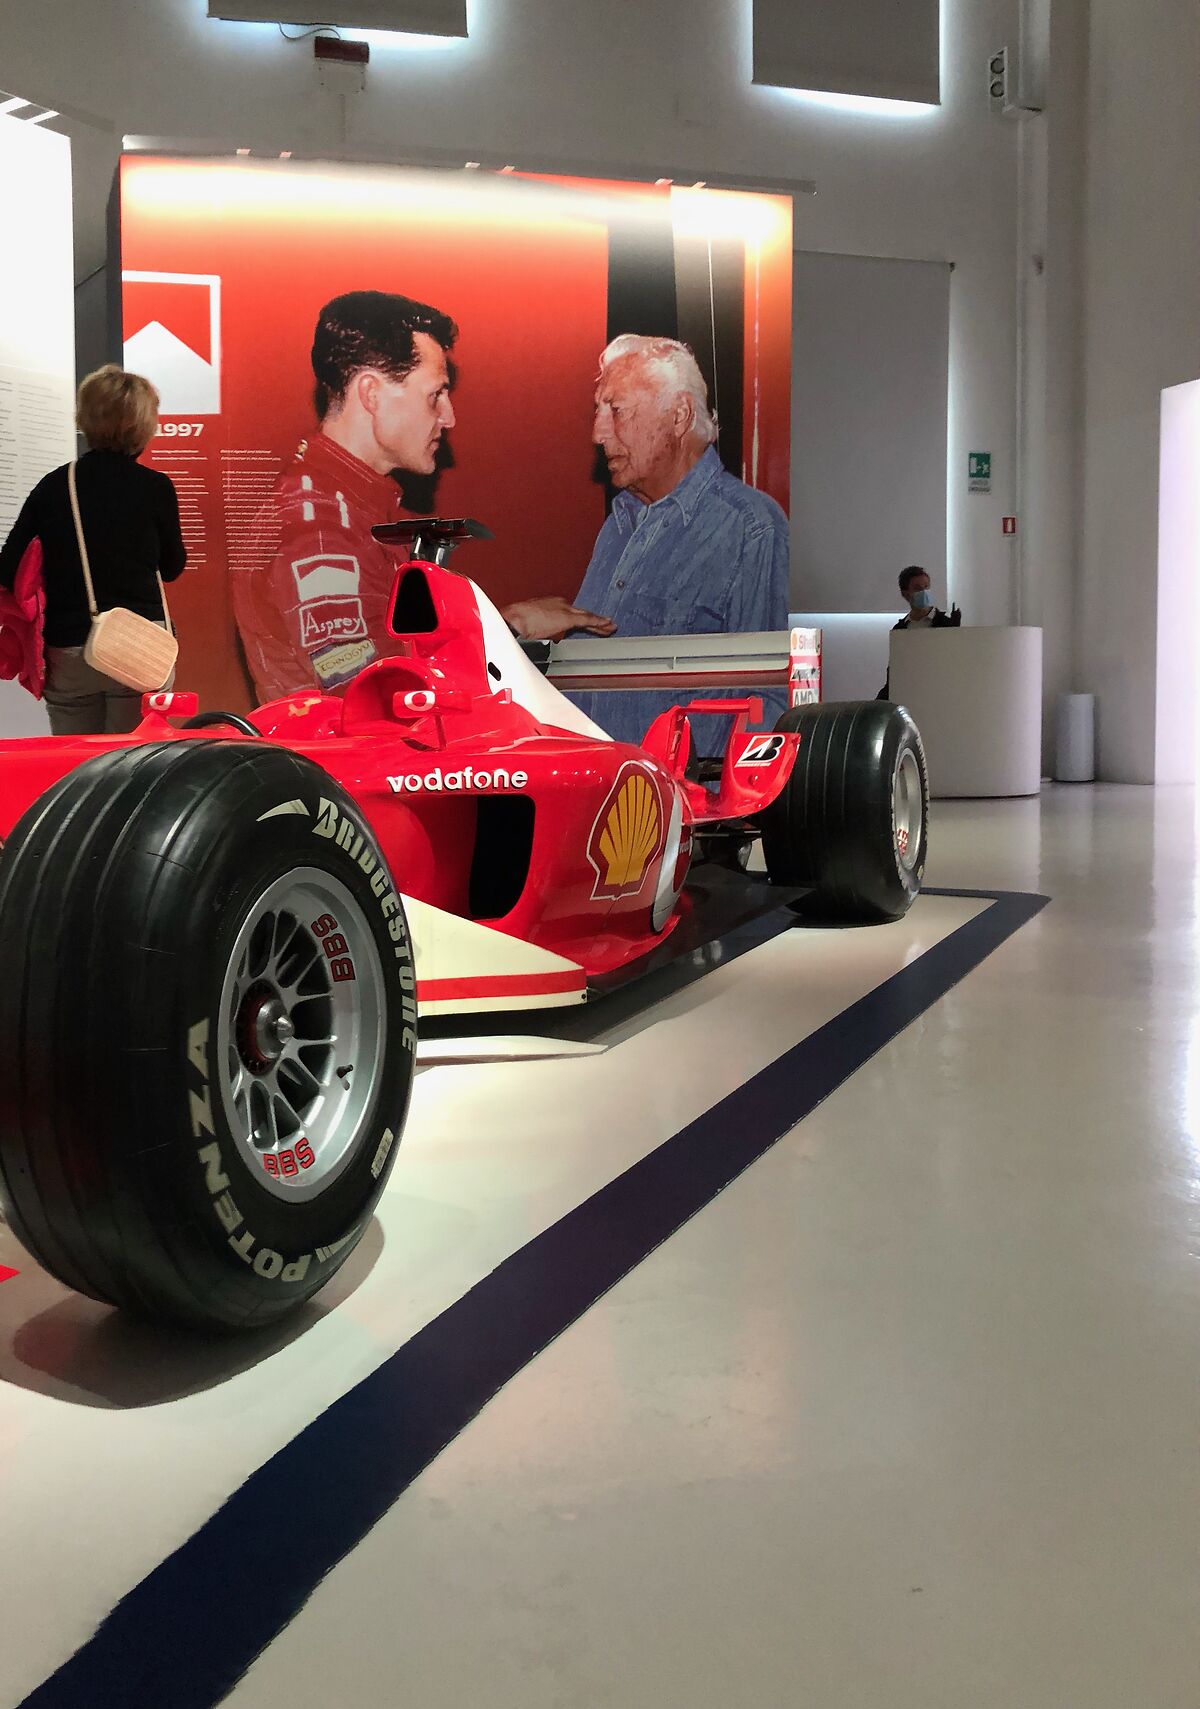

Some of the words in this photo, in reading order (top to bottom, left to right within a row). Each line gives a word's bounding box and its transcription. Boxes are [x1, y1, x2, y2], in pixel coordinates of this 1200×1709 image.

[154, 423, 204, 437] 1997
[304, 612, 360, 637] Asprey
[387, 766, 528, 793] vodafone
[311, 796, 417, 1056] BRIDGESTONE
[310, 913, 356, 982] BBS
[187, 1017, 312, 1282] POTENZA
[263, 1138, 316, 1179] BBS
